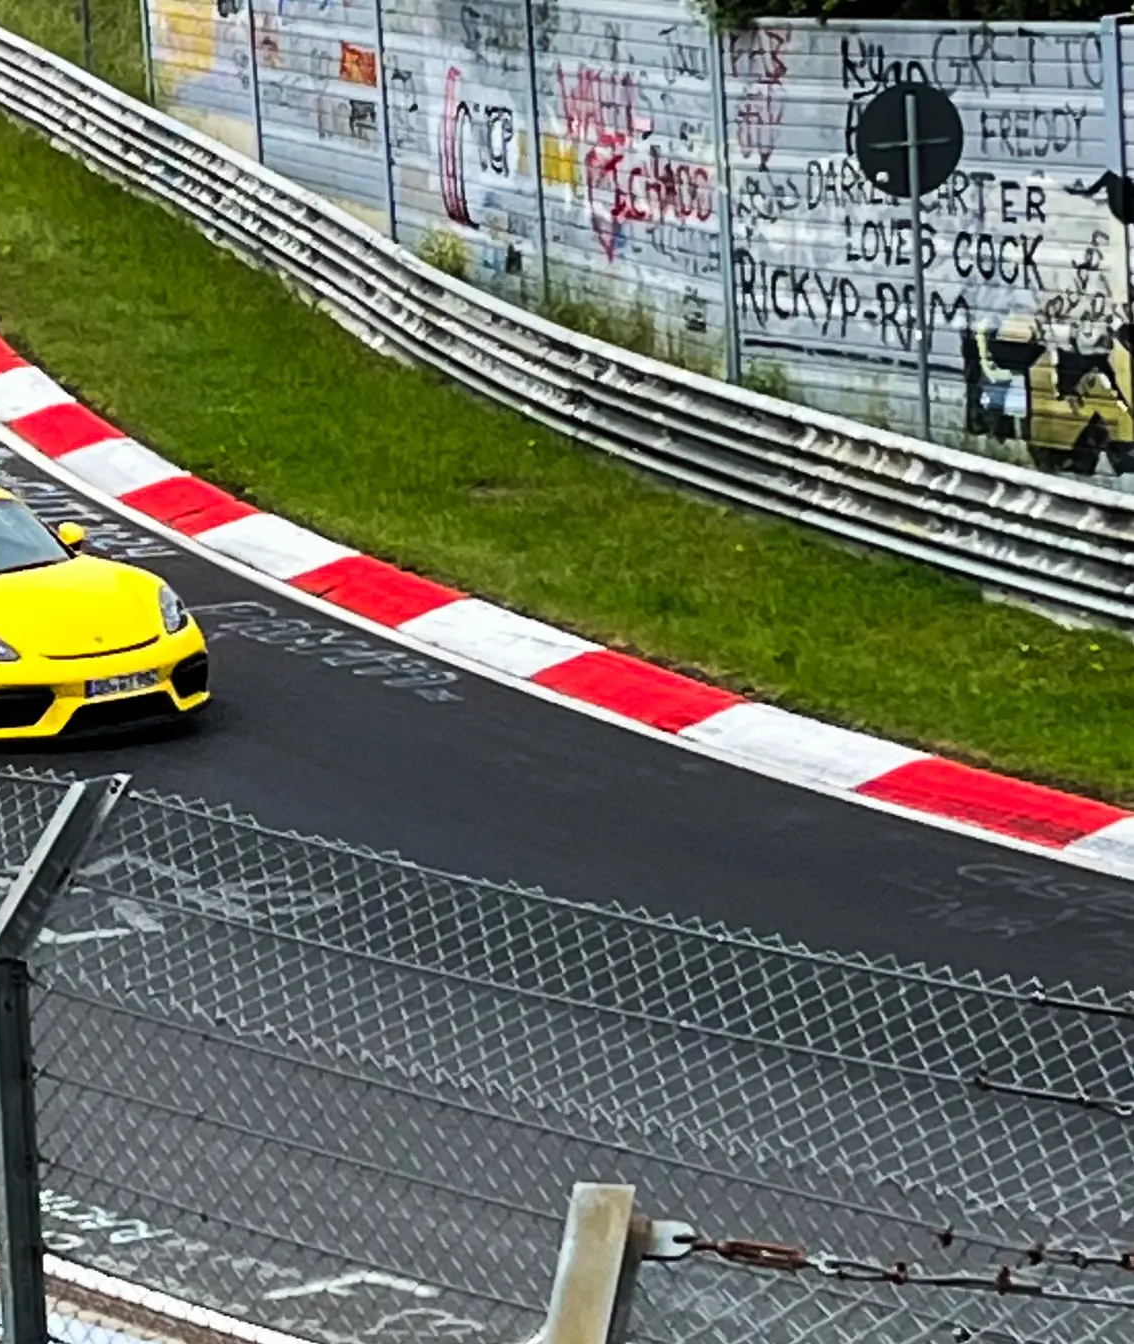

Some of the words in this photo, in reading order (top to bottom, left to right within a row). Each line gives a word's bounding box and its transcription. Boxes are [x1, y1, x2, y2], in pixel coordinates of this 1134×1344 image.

[980, 101, 1088, 158] FREDDY
[843, 214, 938, 269] LOVES
[953, 230, 1046, 291] COCK
